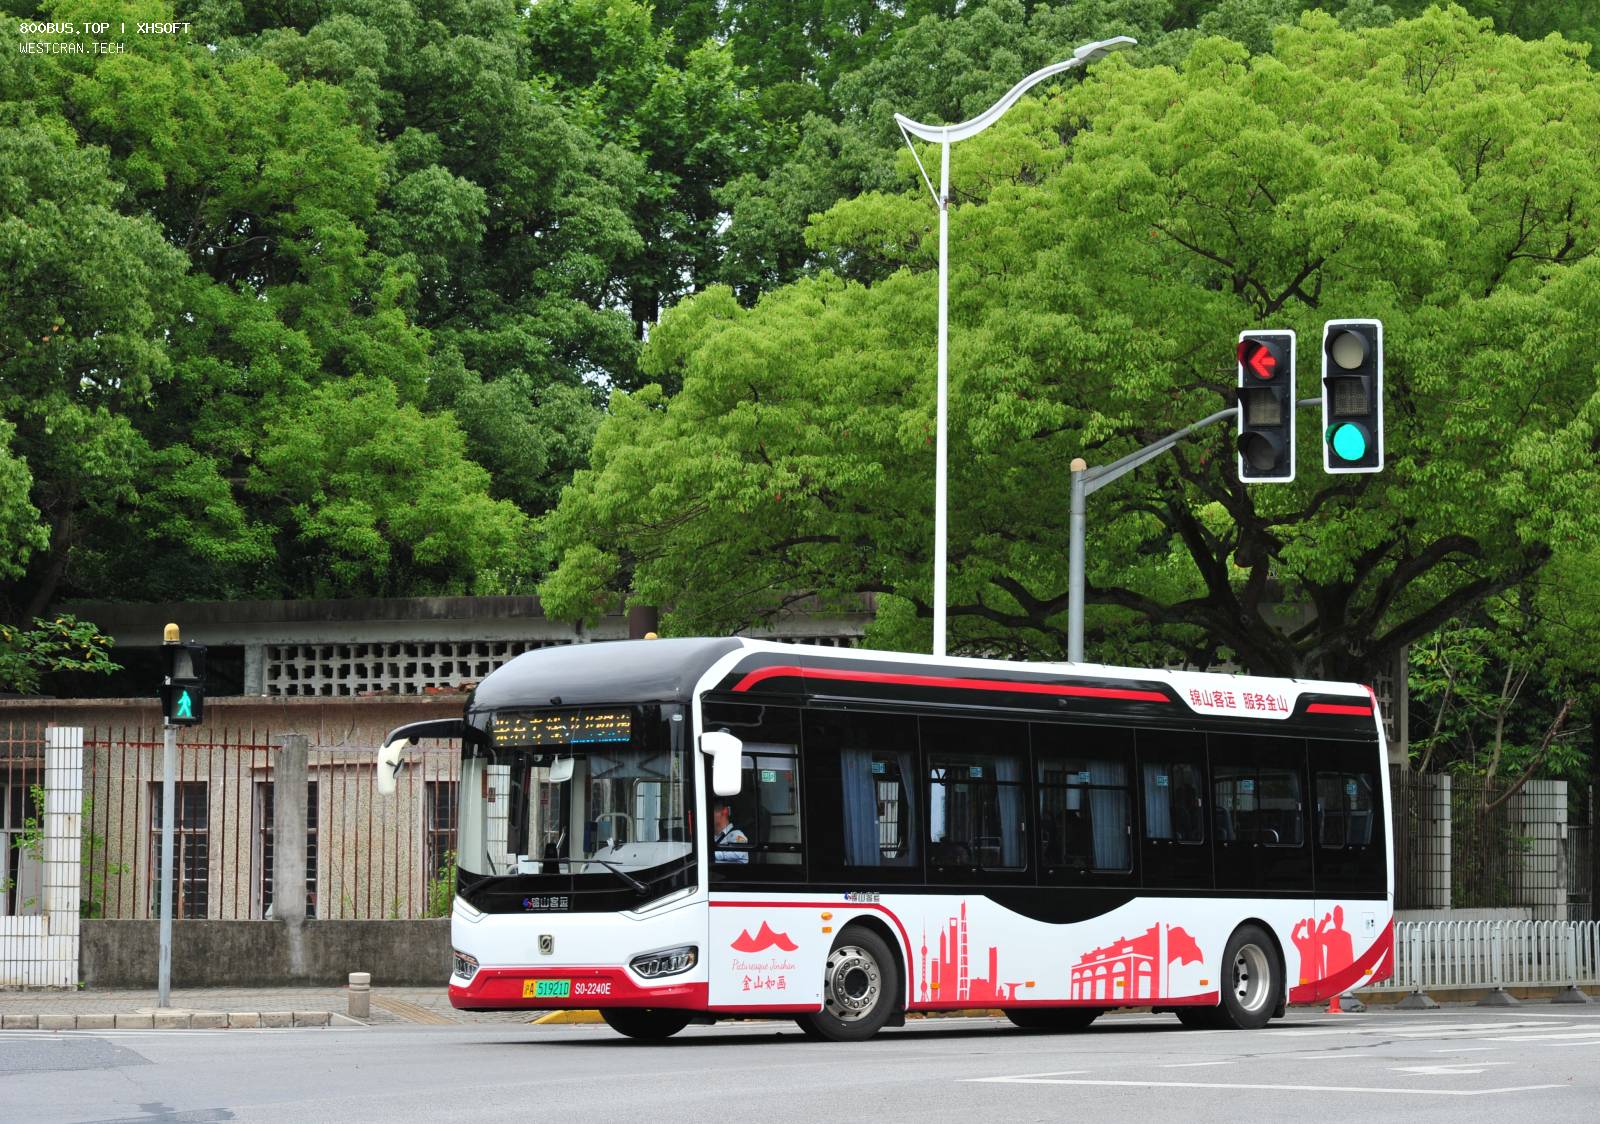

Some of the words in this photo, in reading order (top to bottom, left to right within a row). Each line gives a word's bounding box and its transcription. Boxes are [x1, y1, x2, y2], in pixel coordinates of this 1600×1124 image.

[1189, 689, 1237, 709] 锦山客运
[1242, 692, 1289, 712] 服务金山
[742, 974, 786, 991] 金山如画
